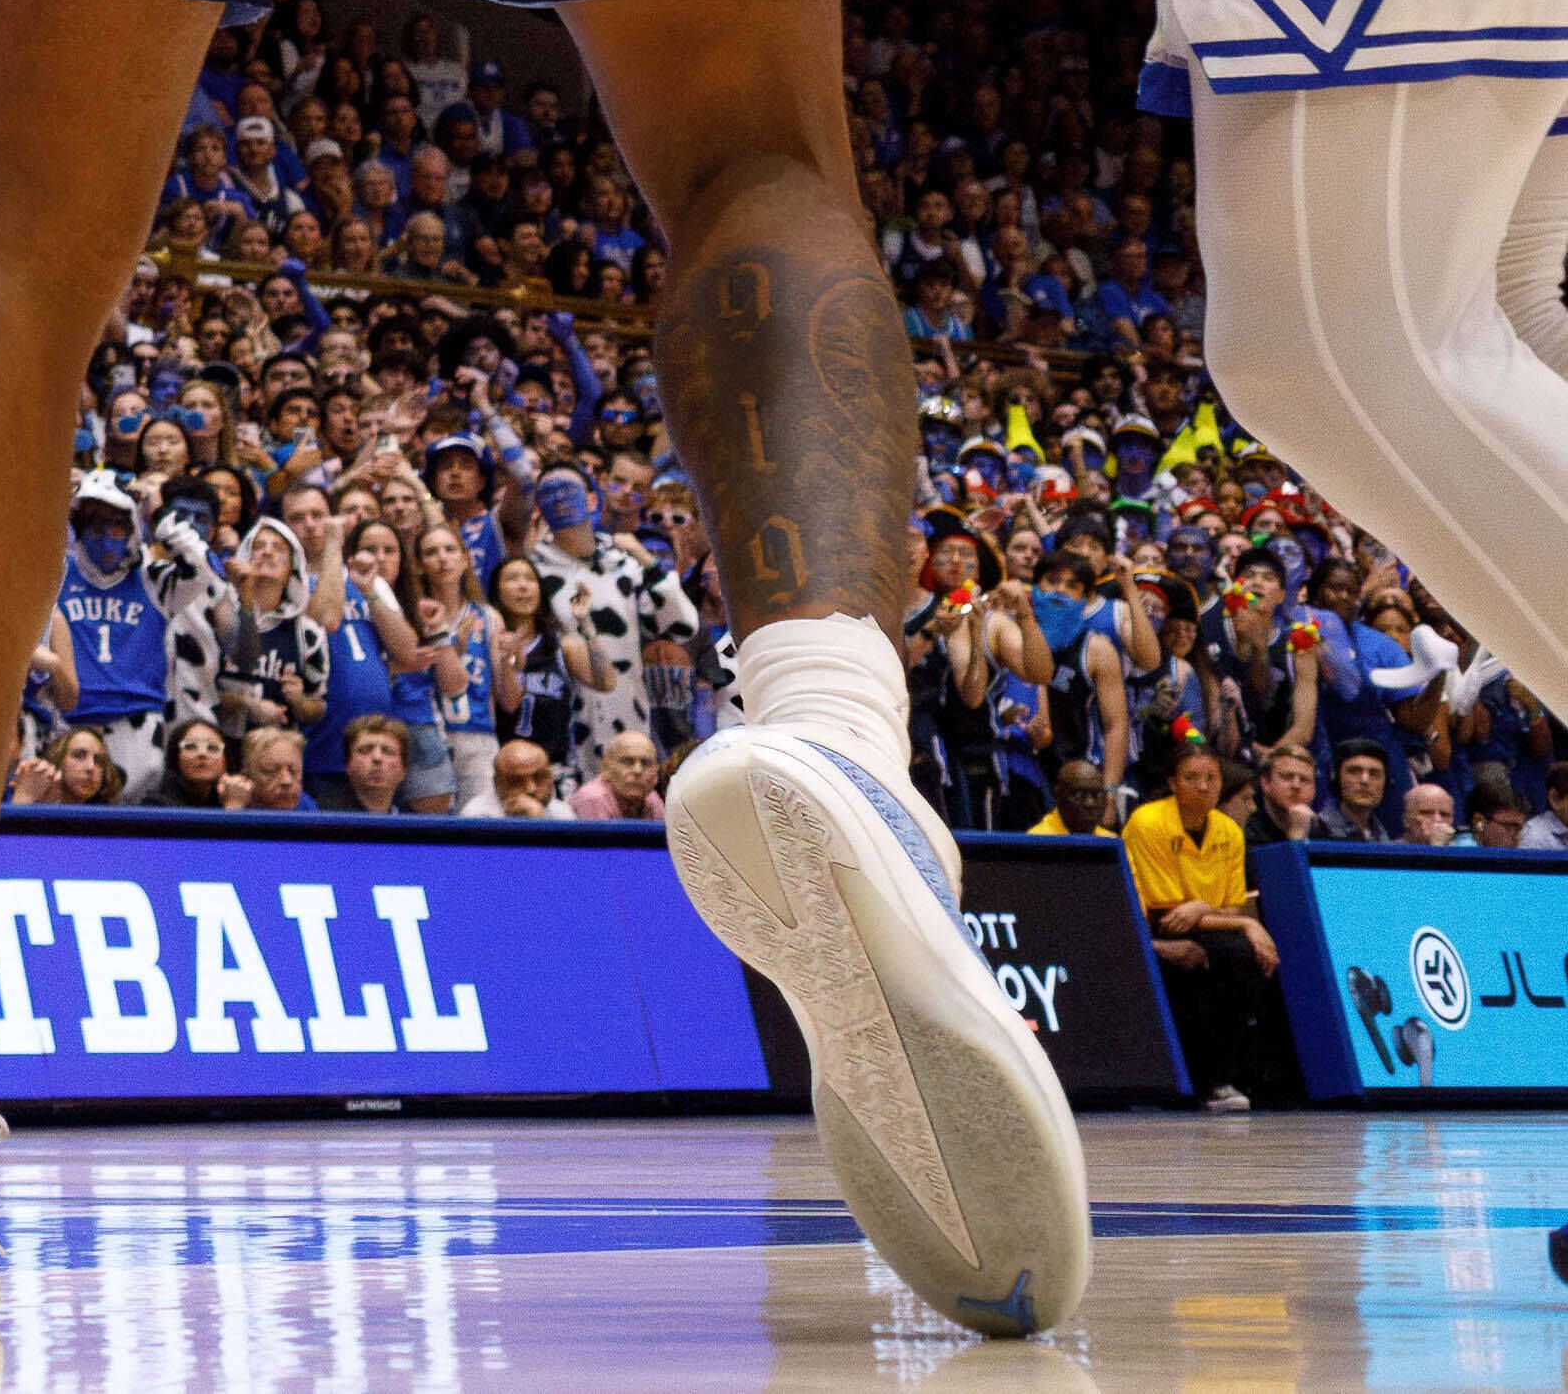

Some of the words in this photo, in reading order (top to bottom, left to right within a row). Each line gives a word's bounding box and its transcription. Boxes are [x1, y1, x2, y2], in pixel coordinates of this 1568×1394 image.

[65, 597, 144, 625] DUKE
[98, 624, 114, 663] 1
[344, 623, 366, 663] 1
[515, 694, 535, 737] 1
